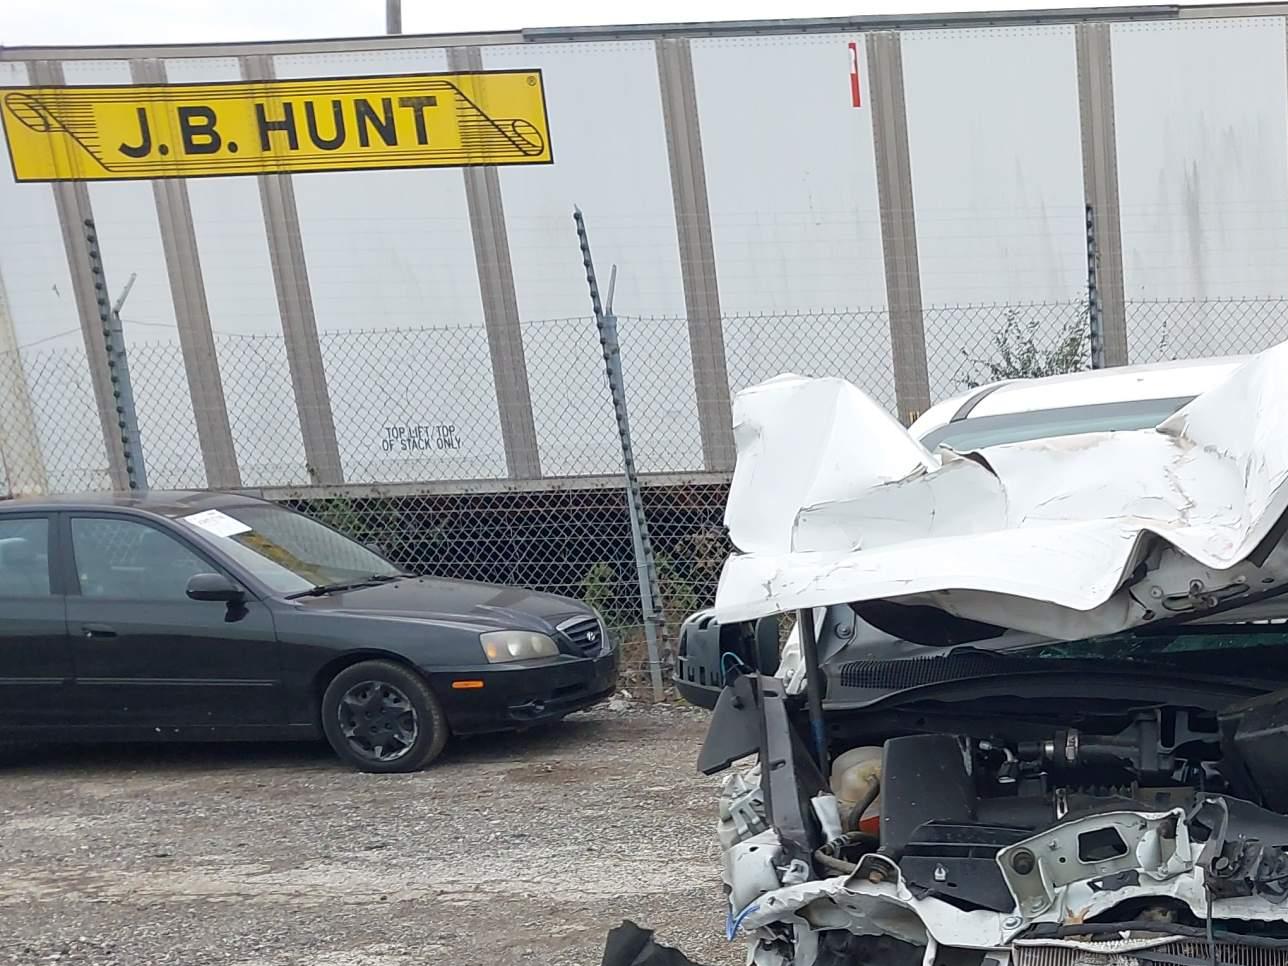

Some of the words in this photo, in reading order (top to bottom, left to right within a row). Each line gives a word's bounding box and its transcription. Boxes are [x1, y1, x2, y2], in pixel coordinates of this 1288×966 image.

[118, 105, 239, 159] J.B.
[256, 95, 439, 153] HUNT
[385, 426, 405, 439] TOP
[381, 438, 394, 451] OF
[400, 437, 432, 451] STACK
[436, 436, 461, 450] ONLY
